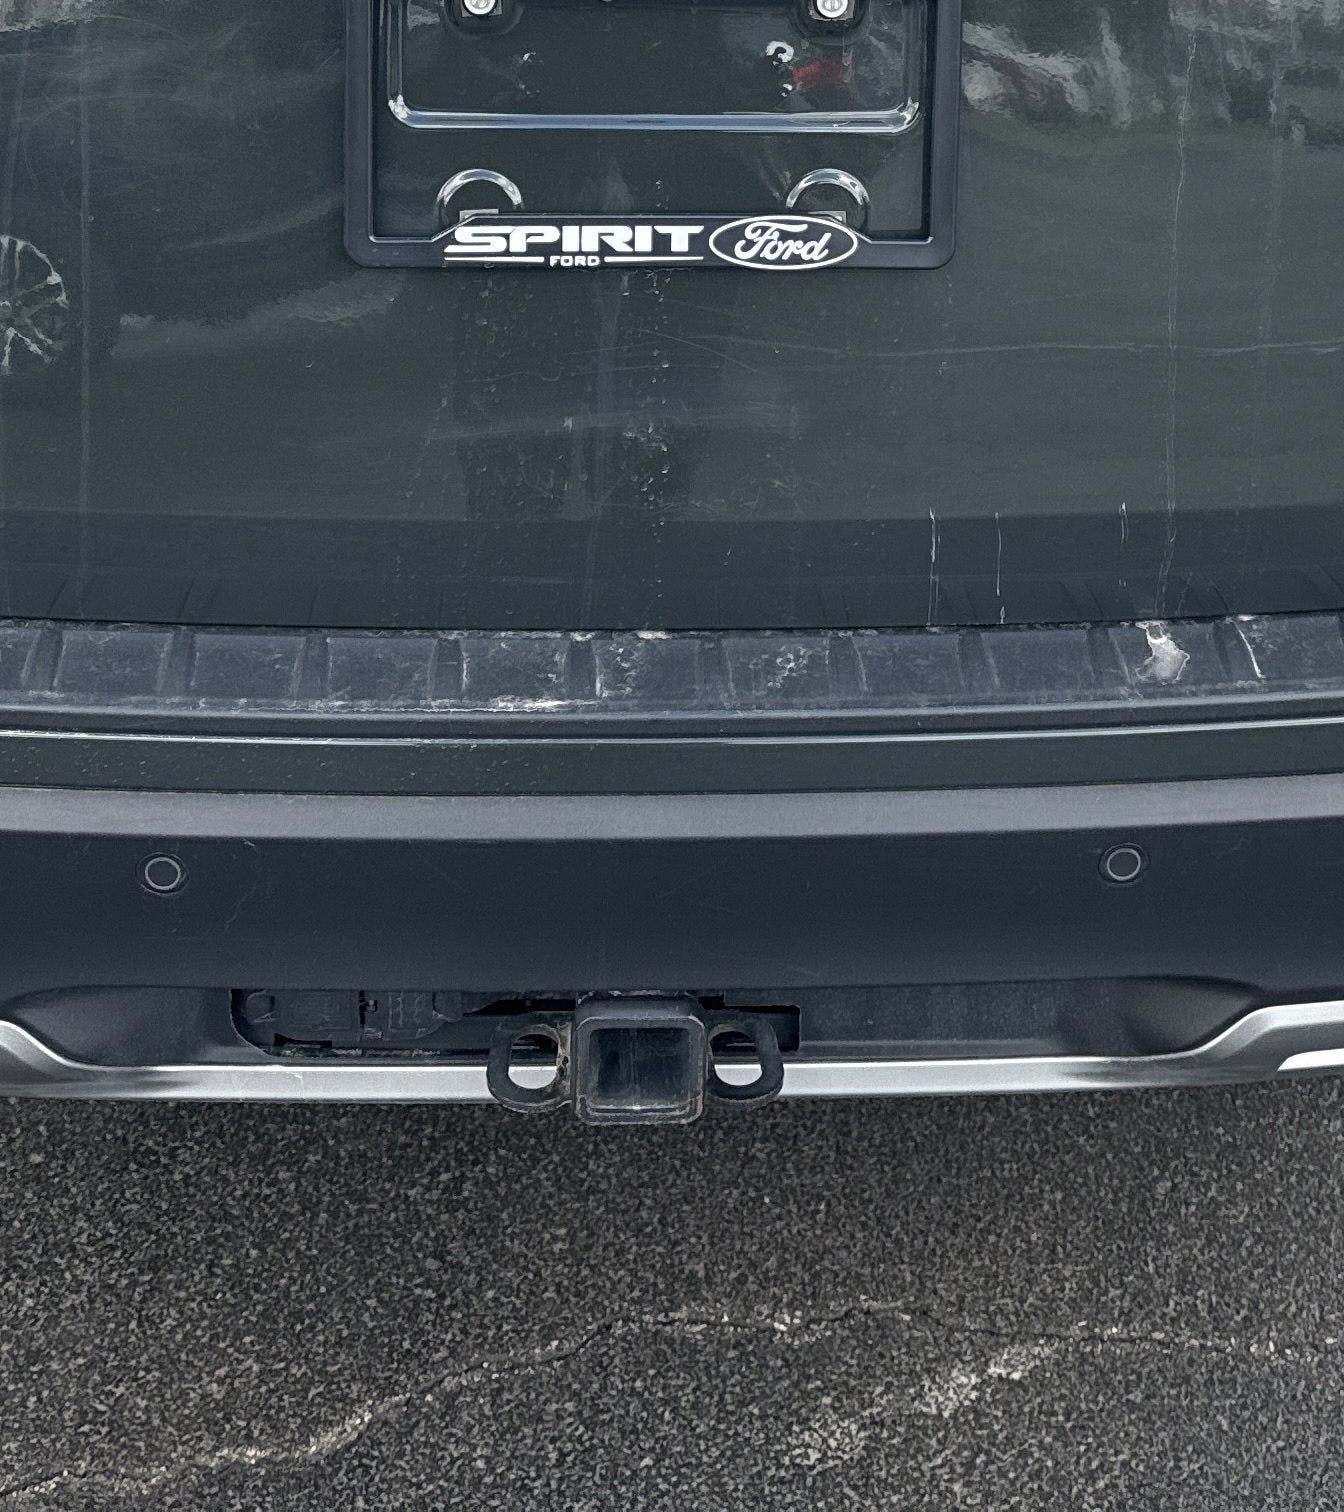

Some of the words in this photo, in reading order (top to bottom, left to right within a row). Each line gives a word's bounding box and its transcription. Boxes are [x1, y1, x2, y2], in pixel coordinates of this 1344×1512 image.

[445, 224, 705, 253] SPIRIT
[734, 223, 832, 262] Ford
[549, 255, 601, 267] FORD
